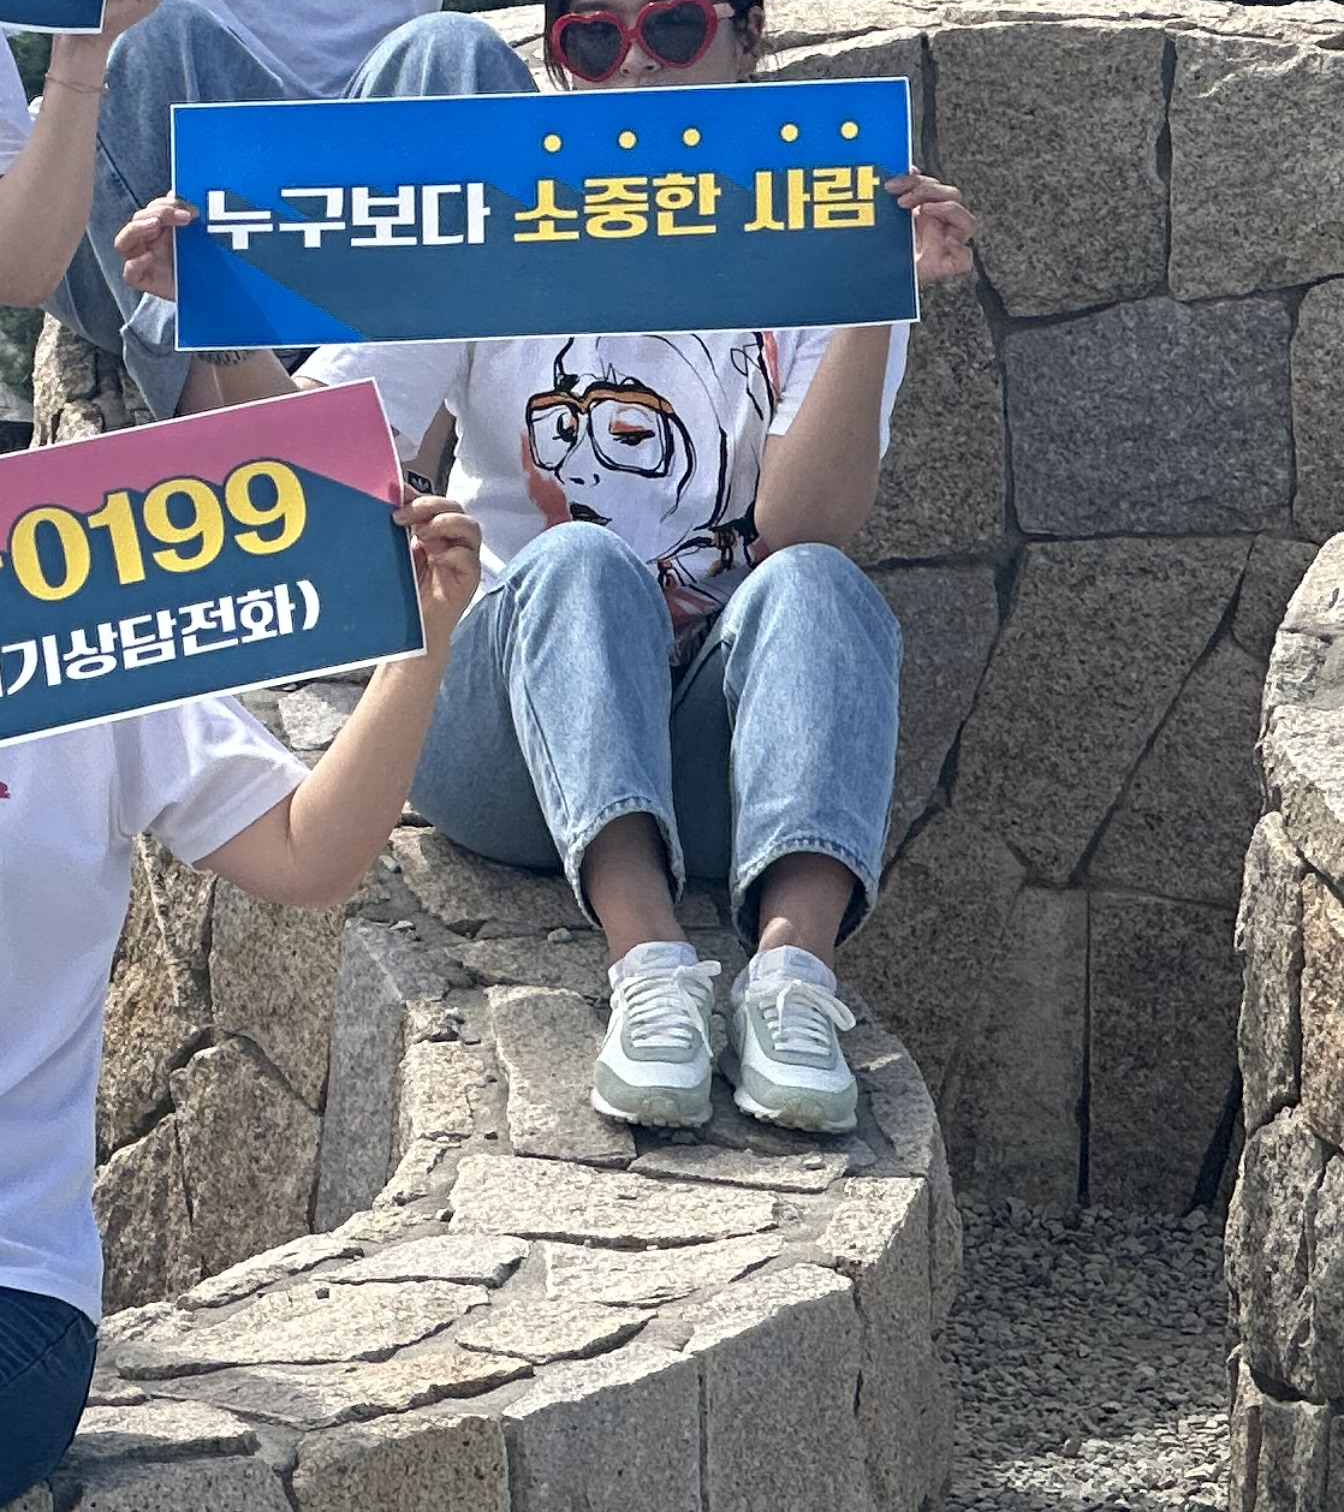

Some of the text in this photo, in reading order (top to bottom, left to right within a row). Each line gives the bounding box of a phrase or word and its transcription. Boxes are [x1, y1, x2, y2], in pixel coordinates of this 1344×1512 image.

[206, 166, 880, 251] 누구보다 소중한 사람
